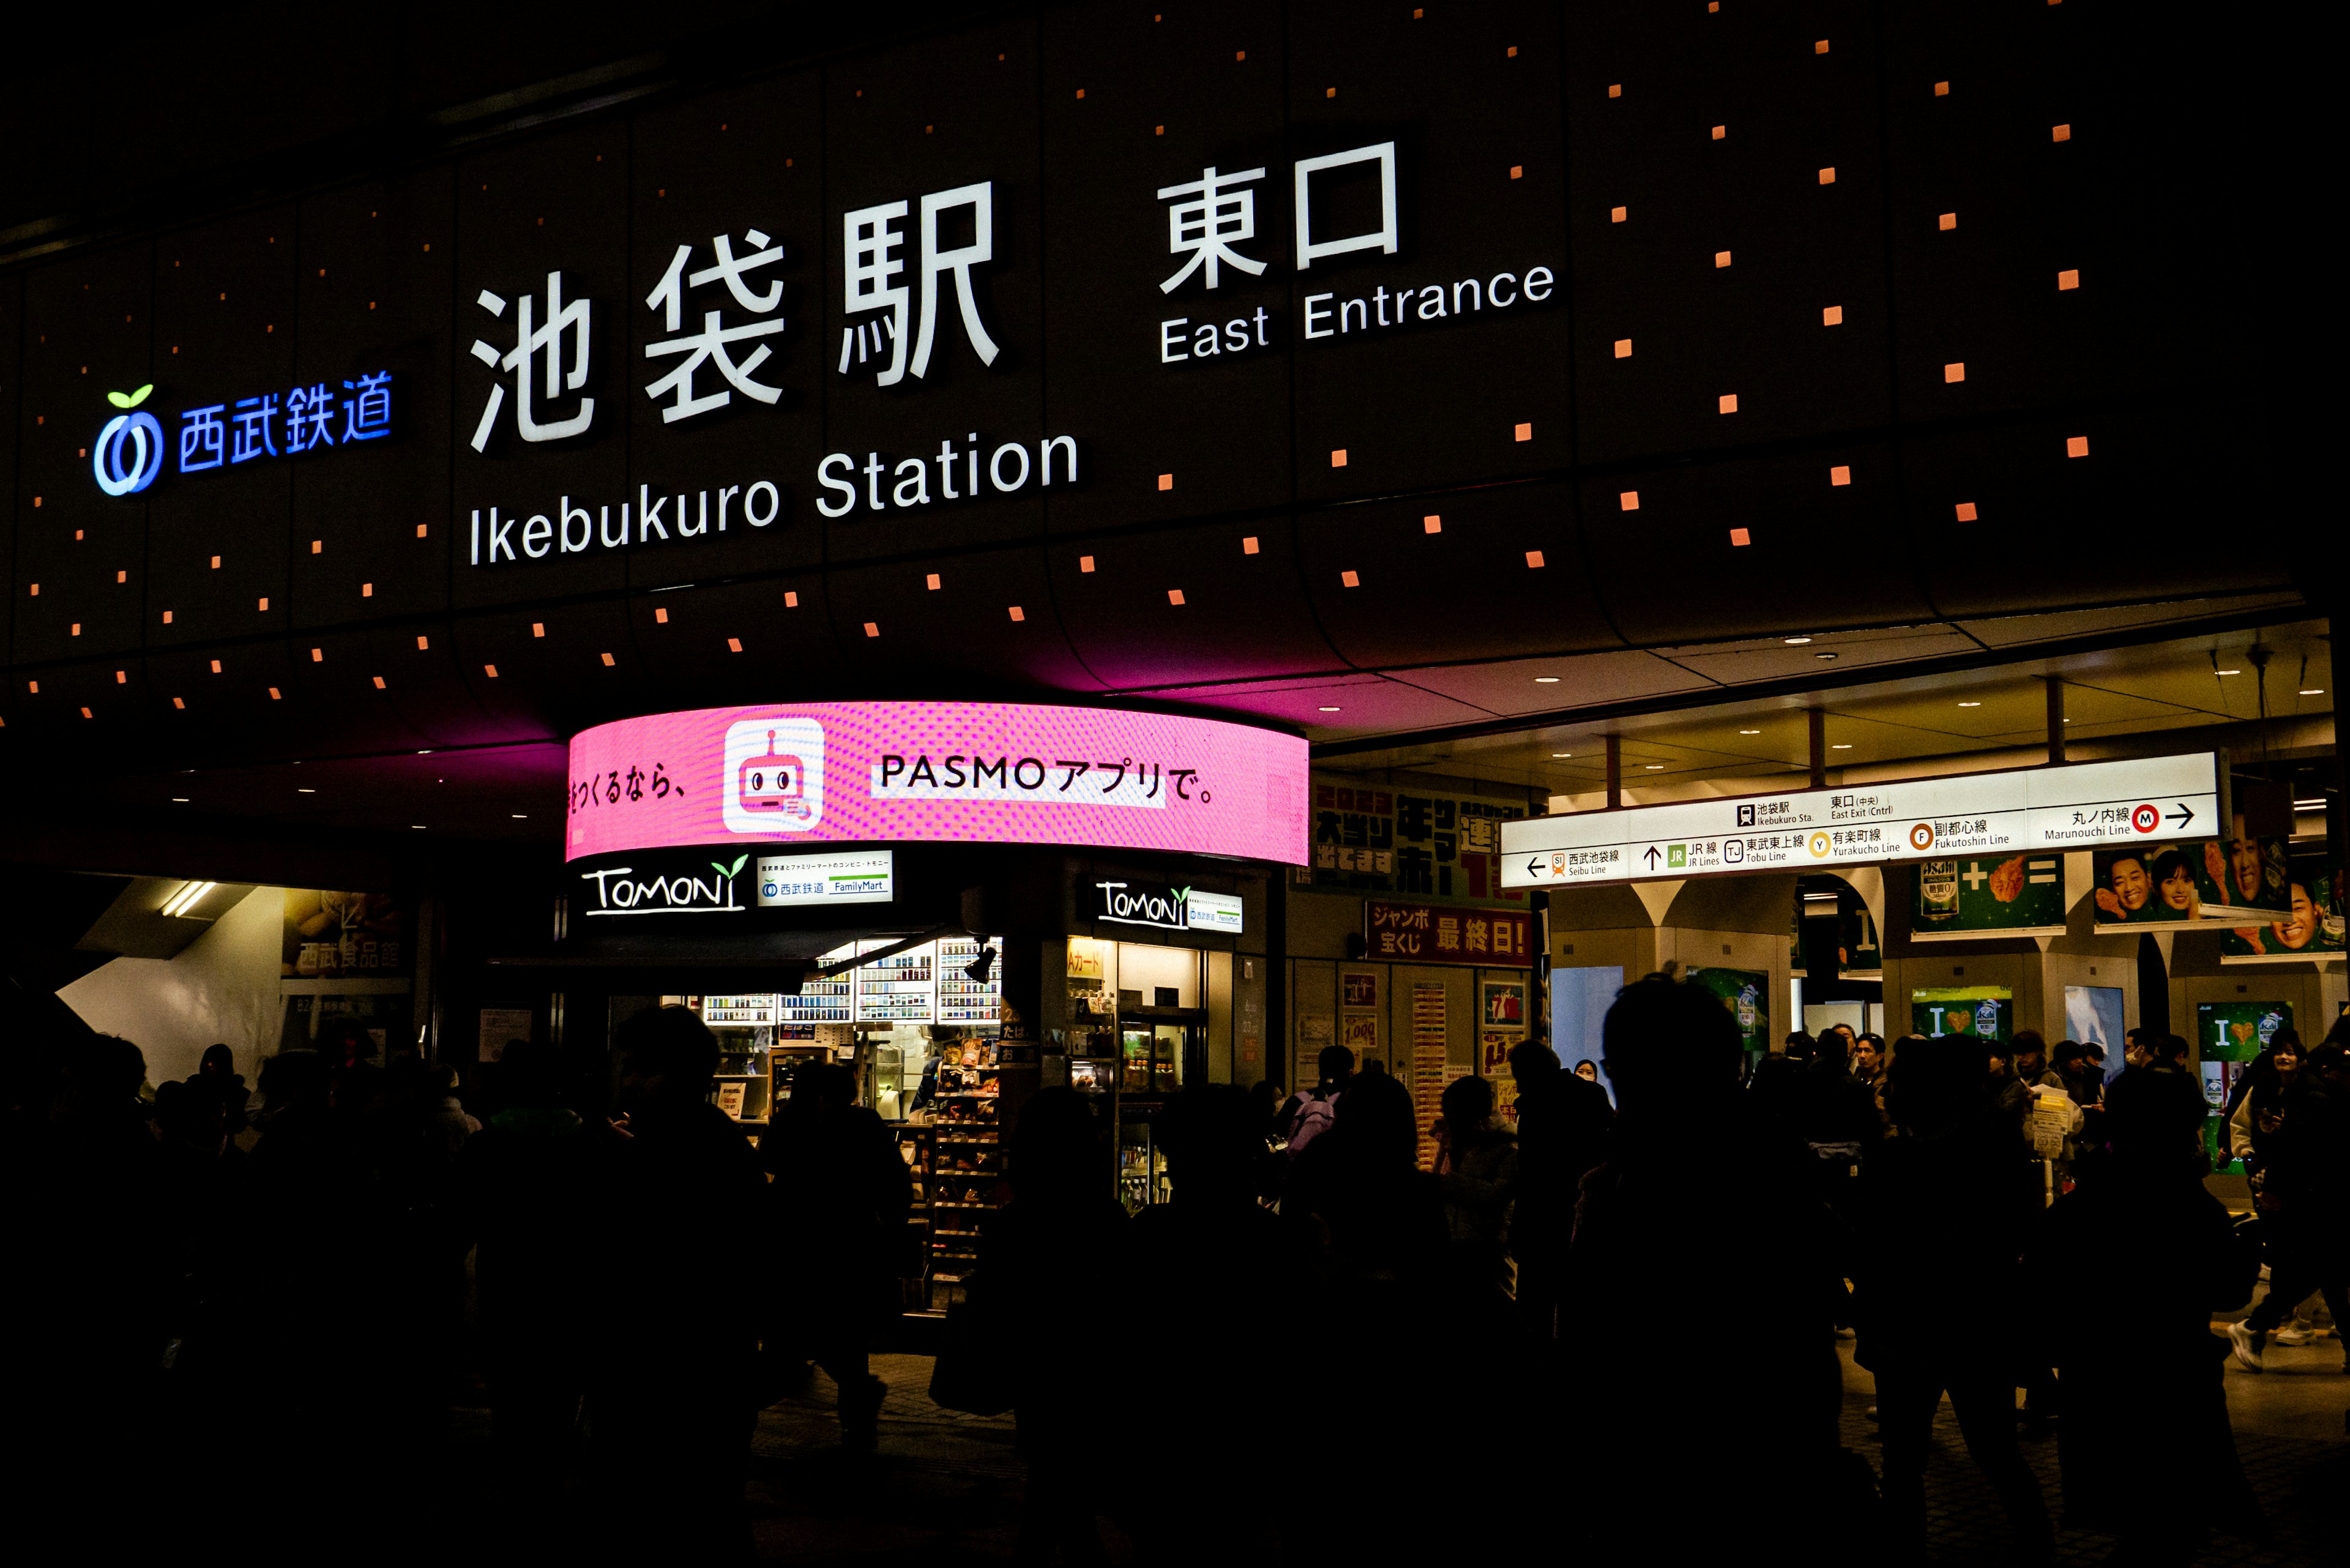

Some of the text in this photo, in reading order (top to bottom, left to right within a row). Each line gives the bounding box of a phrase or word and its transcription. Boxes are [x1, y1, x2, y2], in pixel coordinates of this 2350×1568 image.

[1157, 140, 1398, 295] 東口
[470, 180, 1000, 454] 池袋駅
[1160, 264, 1554, 364] East Entrance
[179, 370, 393, 474] 西武鉄道
[470, 431, 1078, 566] Ikebukuro Station
[881, 755, 1211, 804] PASMOアプリで。
[1758, 801, 1789, 815] 池袋駅
[1830, 795, 1854, 809] 東口
[1758, 813, 1815, 826] Ikebukuro Sta.
[1831, 805, 1893, 819] East Exit (Cntrl)
[2073, 807, 2130, 825] 丸ノ内線
[2139, 813, 2152, 824] M
[1316, 811, 1393, 849] 大当り
[1934, 819, 1988, 837] 副都心線
[2045, 824, 2130, 840] Marunouchi Line
[1746, 834, 1805, 851] 東武東上線
[1832, 828, 1881, 845] 有楽町線
[1918, 833, 1925, 842] F
[1935, 834, 2009, 849] Fukutoshin Line
[1688, 841, 1717, 856] JR 線
[1728, 846, 1740, 857] TJ
[1816, 840, 1824, 850] Y
[1833, 843, 1901, 857] Yurakucho Line
[1569, 850, 1620, 865] 西武池袋線
[1670, 849, 1684, 862] JR
[1688, 857, 1720, 867] JR Lines
[1746, 851, 1786, 863] Tobu Line
[1569, 865, 1606, 876] Seibu Line
[781, 883, 824, 895] 西武鉄道
[835, 881, 882, 892] FamilyMart
[1373, 906, 1430, 930] ジャンボ
[1380, 931, 1420, 954] 宝くじ
[1438, 916, 1524, 955] 最終日!
[299, 940, 401, 969] 西武食品館
[1929, 1007, 1945, 1038] I
[2214, 1019, 2231, 1047] I
